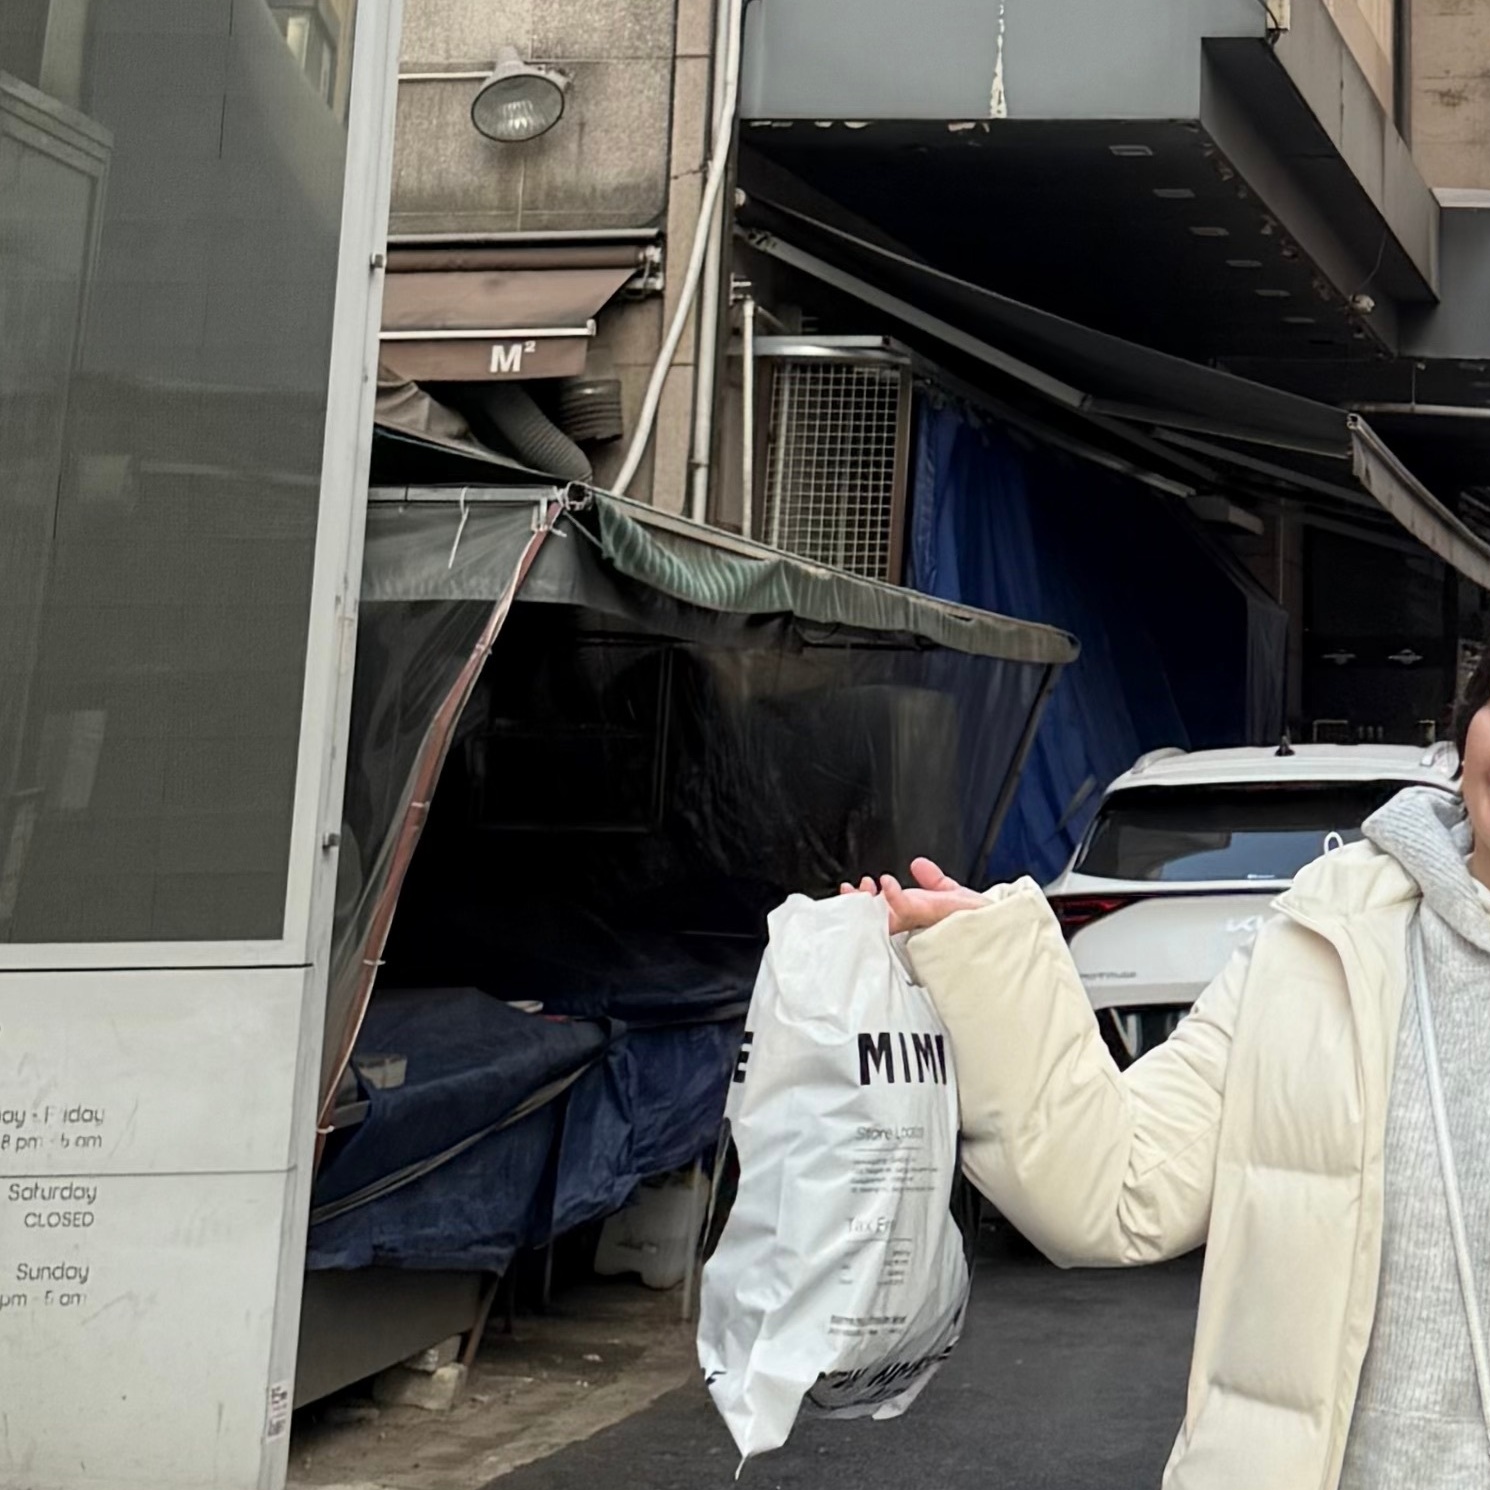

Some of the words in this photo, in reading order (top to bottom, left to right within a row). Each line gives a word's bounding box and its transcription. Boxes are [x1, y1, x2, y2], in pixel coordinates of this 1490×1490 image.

[857, 1031, 947, 1085] MIMI
[0, 1109, 26, 1129] ay
[74, 1133, 103, 1149] am
[8, 1182, 98, 1205] Saturday
[24, 1211, 95, 1228] CLOSED
[16, 1261, 90, 1284] Sunday
